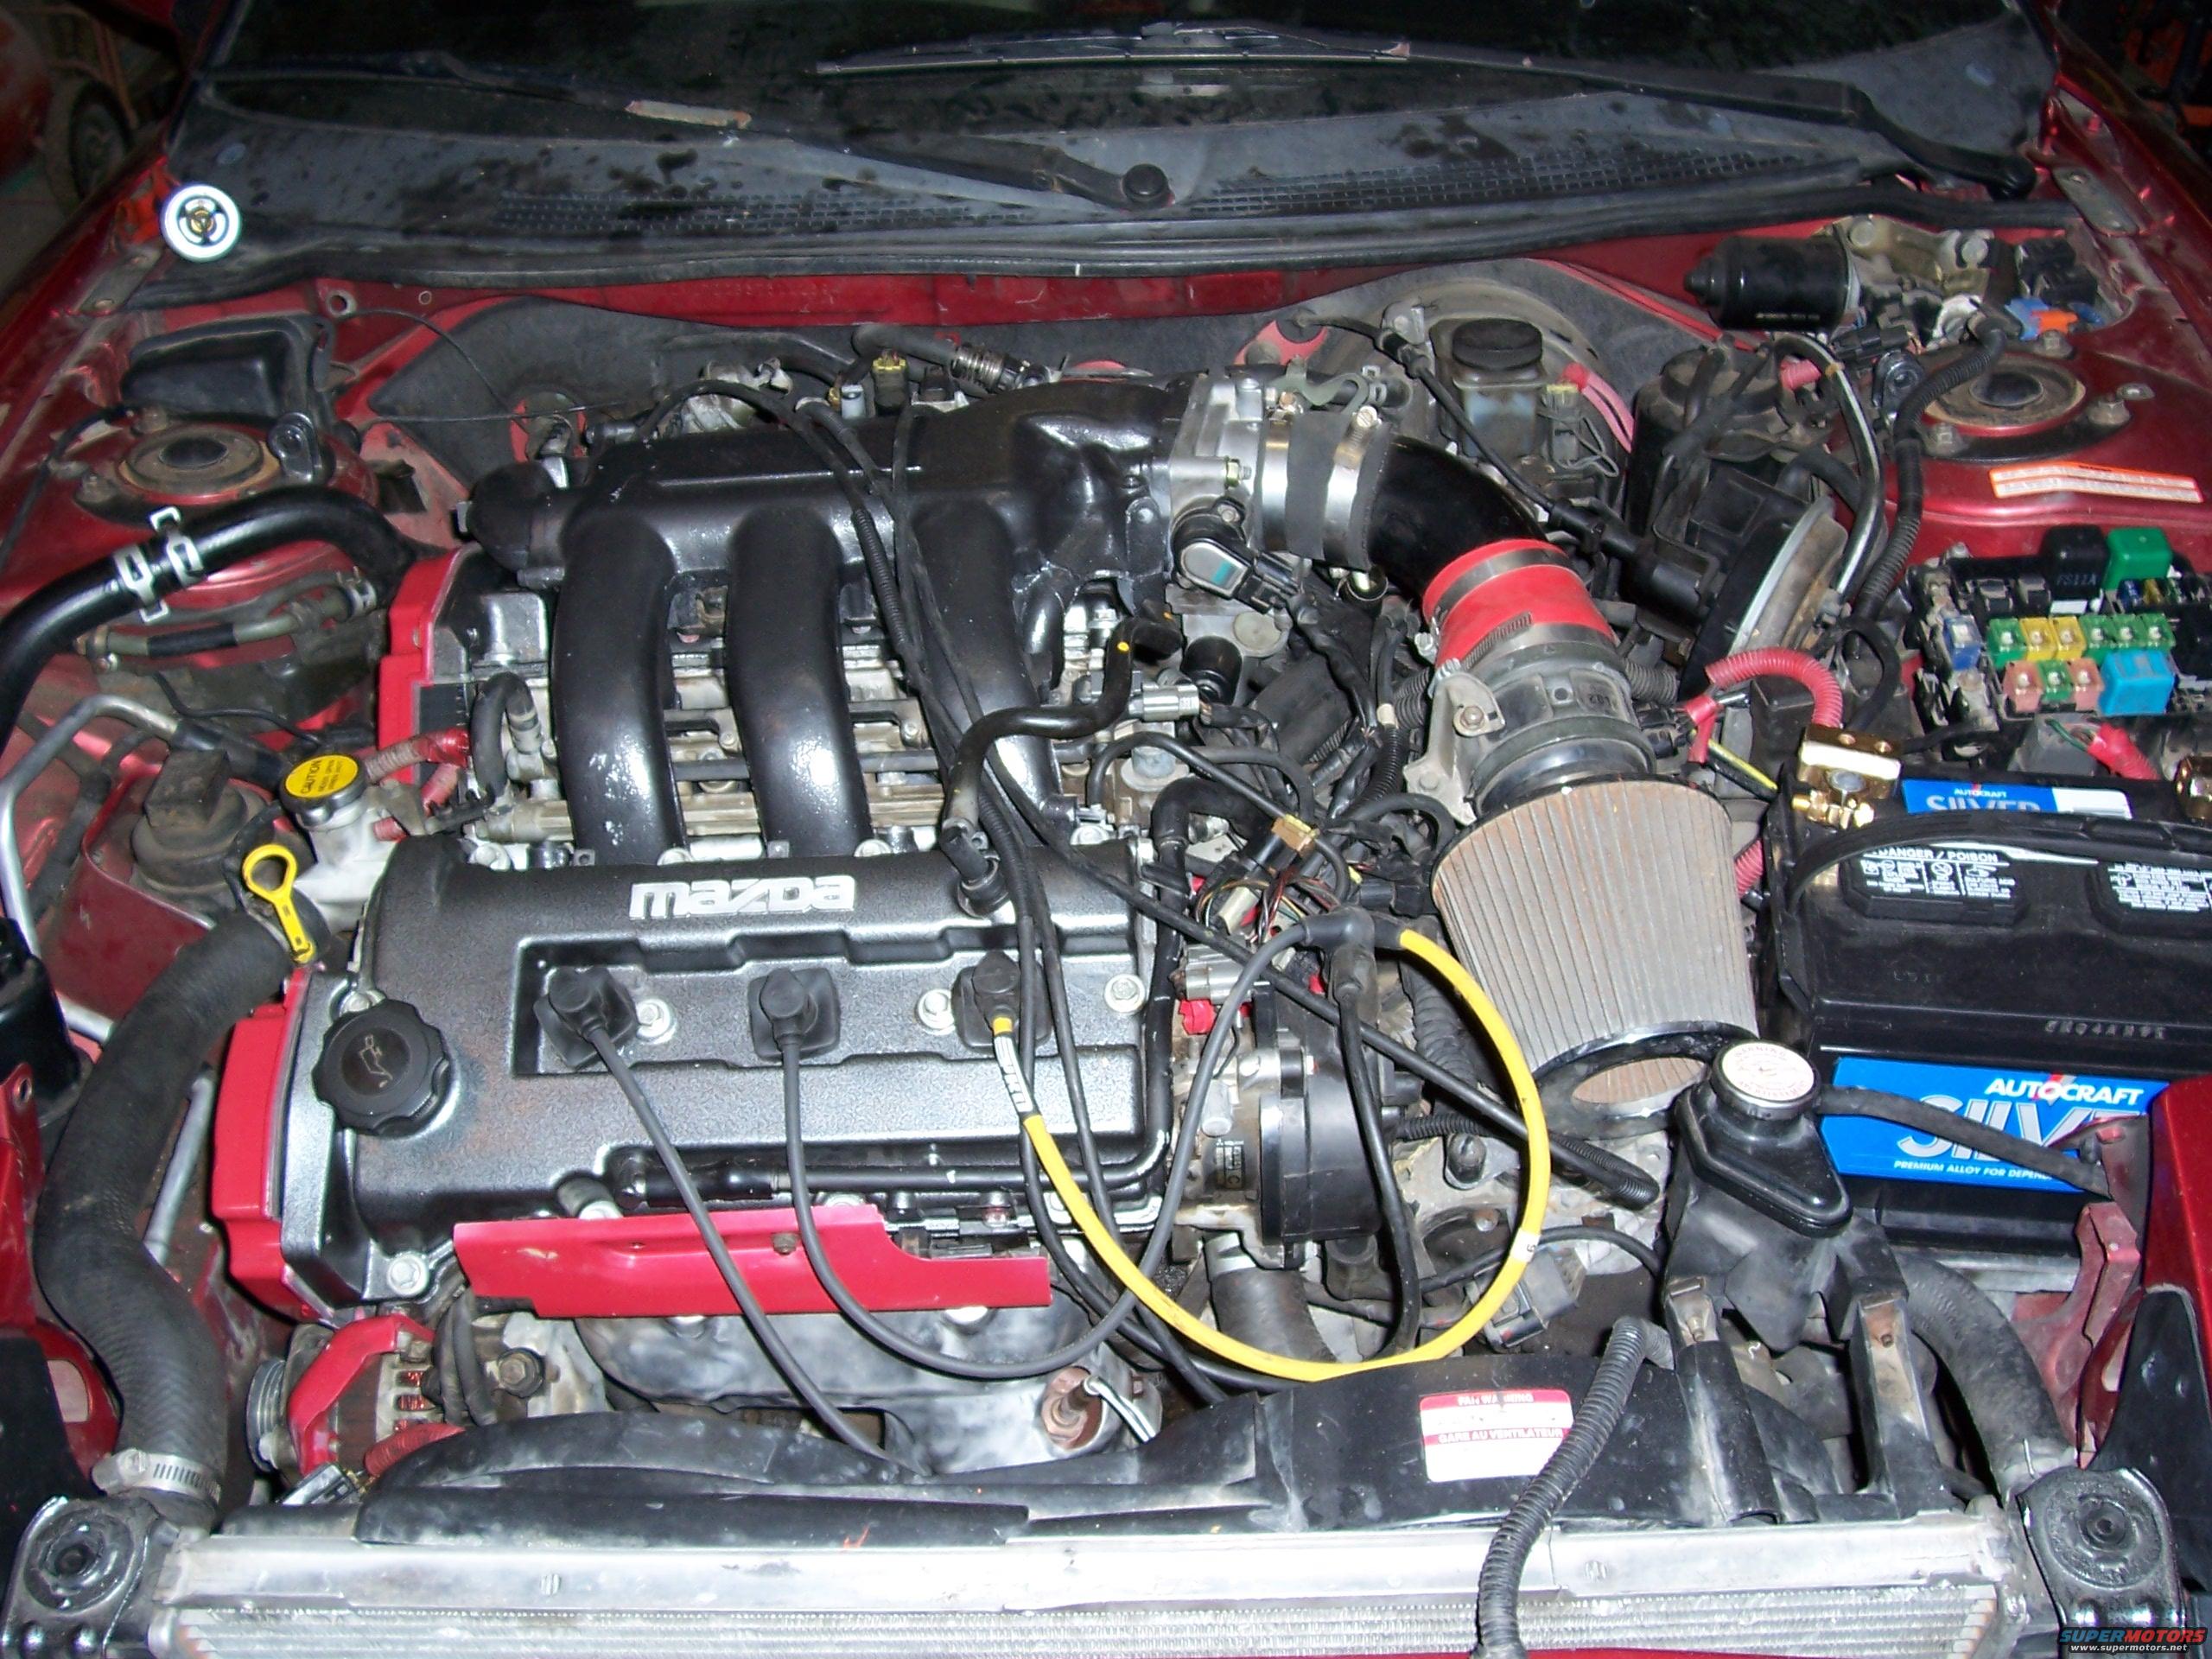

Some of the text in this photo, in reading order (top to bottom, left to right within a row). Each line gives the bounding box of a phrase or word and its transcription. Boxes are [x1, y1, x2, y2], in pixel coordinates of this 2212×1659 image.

[300, 760, 322, 794] CAUTION
[1954, 787, 2006, 798] AUTOCRAFT
[1948, 850, 1999, 862] POISON
[1985, 1077, 2144, 1106] AUTOCRAFT
[1893, 1160, 1944, 1172] PREMIUM
[1947, 1164, 1981, 1175] ALLOY
[1983, 1166, 2006, 1176] FOR
[1458, 1393, 1535, 1407] FAN WANING
[1472, 1430, 1488, 1441] AU
[1490, 1428, 1564, 1440] VENTILATEUR
